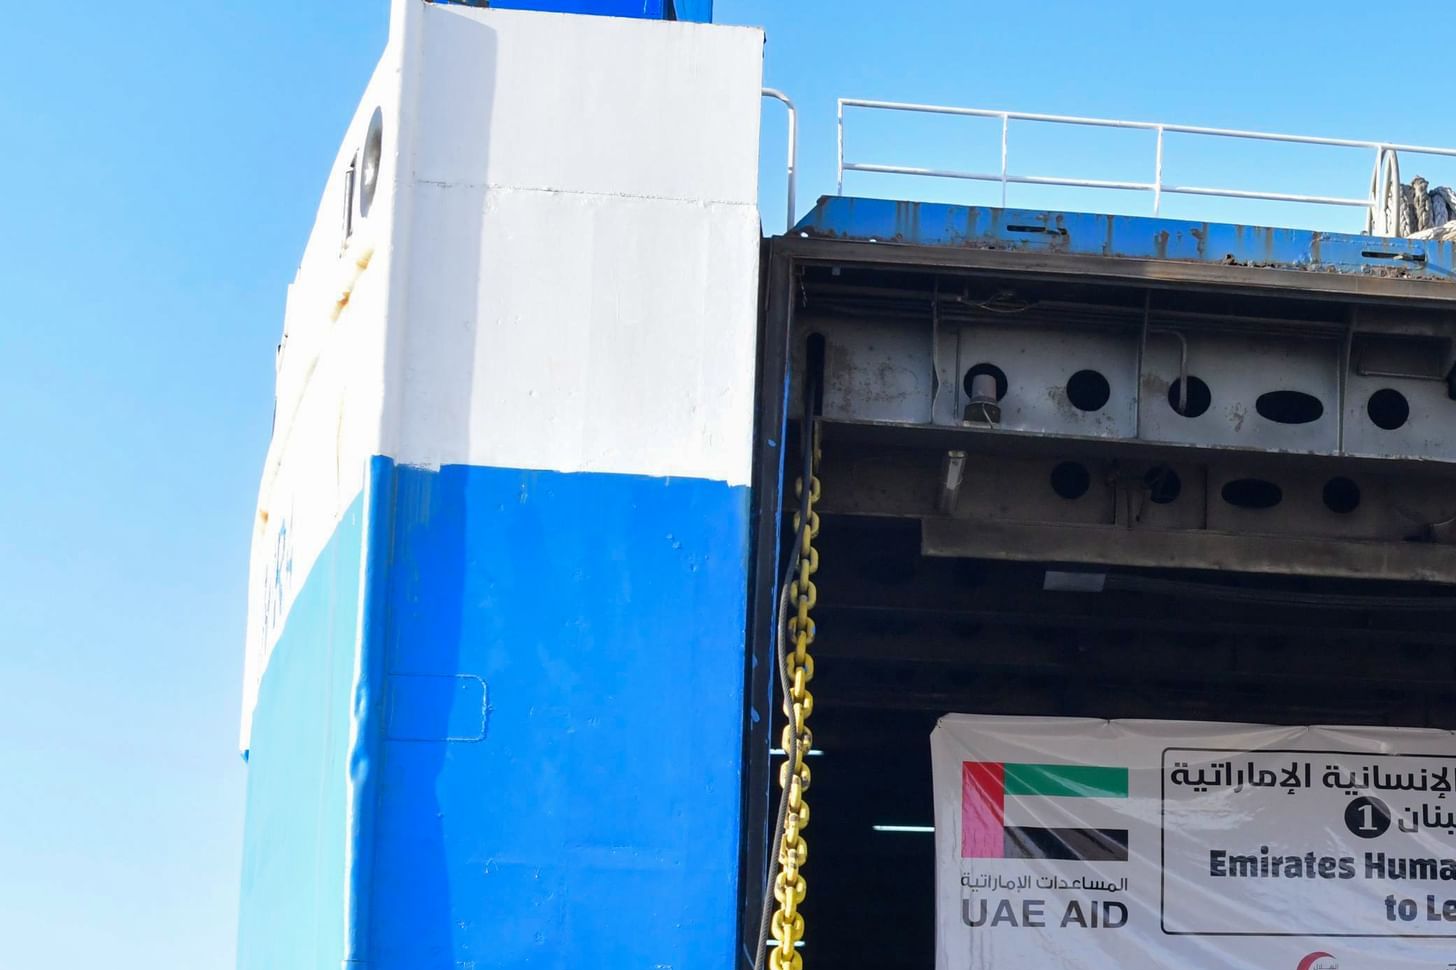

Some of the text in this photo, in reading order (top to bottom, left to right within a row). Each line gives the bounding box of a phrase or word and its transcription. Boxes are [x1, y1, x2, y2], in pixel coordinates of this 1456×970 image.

[1170, 761, 1311, 795] الإماراتية
[1209, 845, 1356, 880] Emirates
[960, 872, 1128, 893] المساعدات الإماراتية
[961, 898, 1129, 929] UAE AID
[1384, 894, 1418, 922] to
